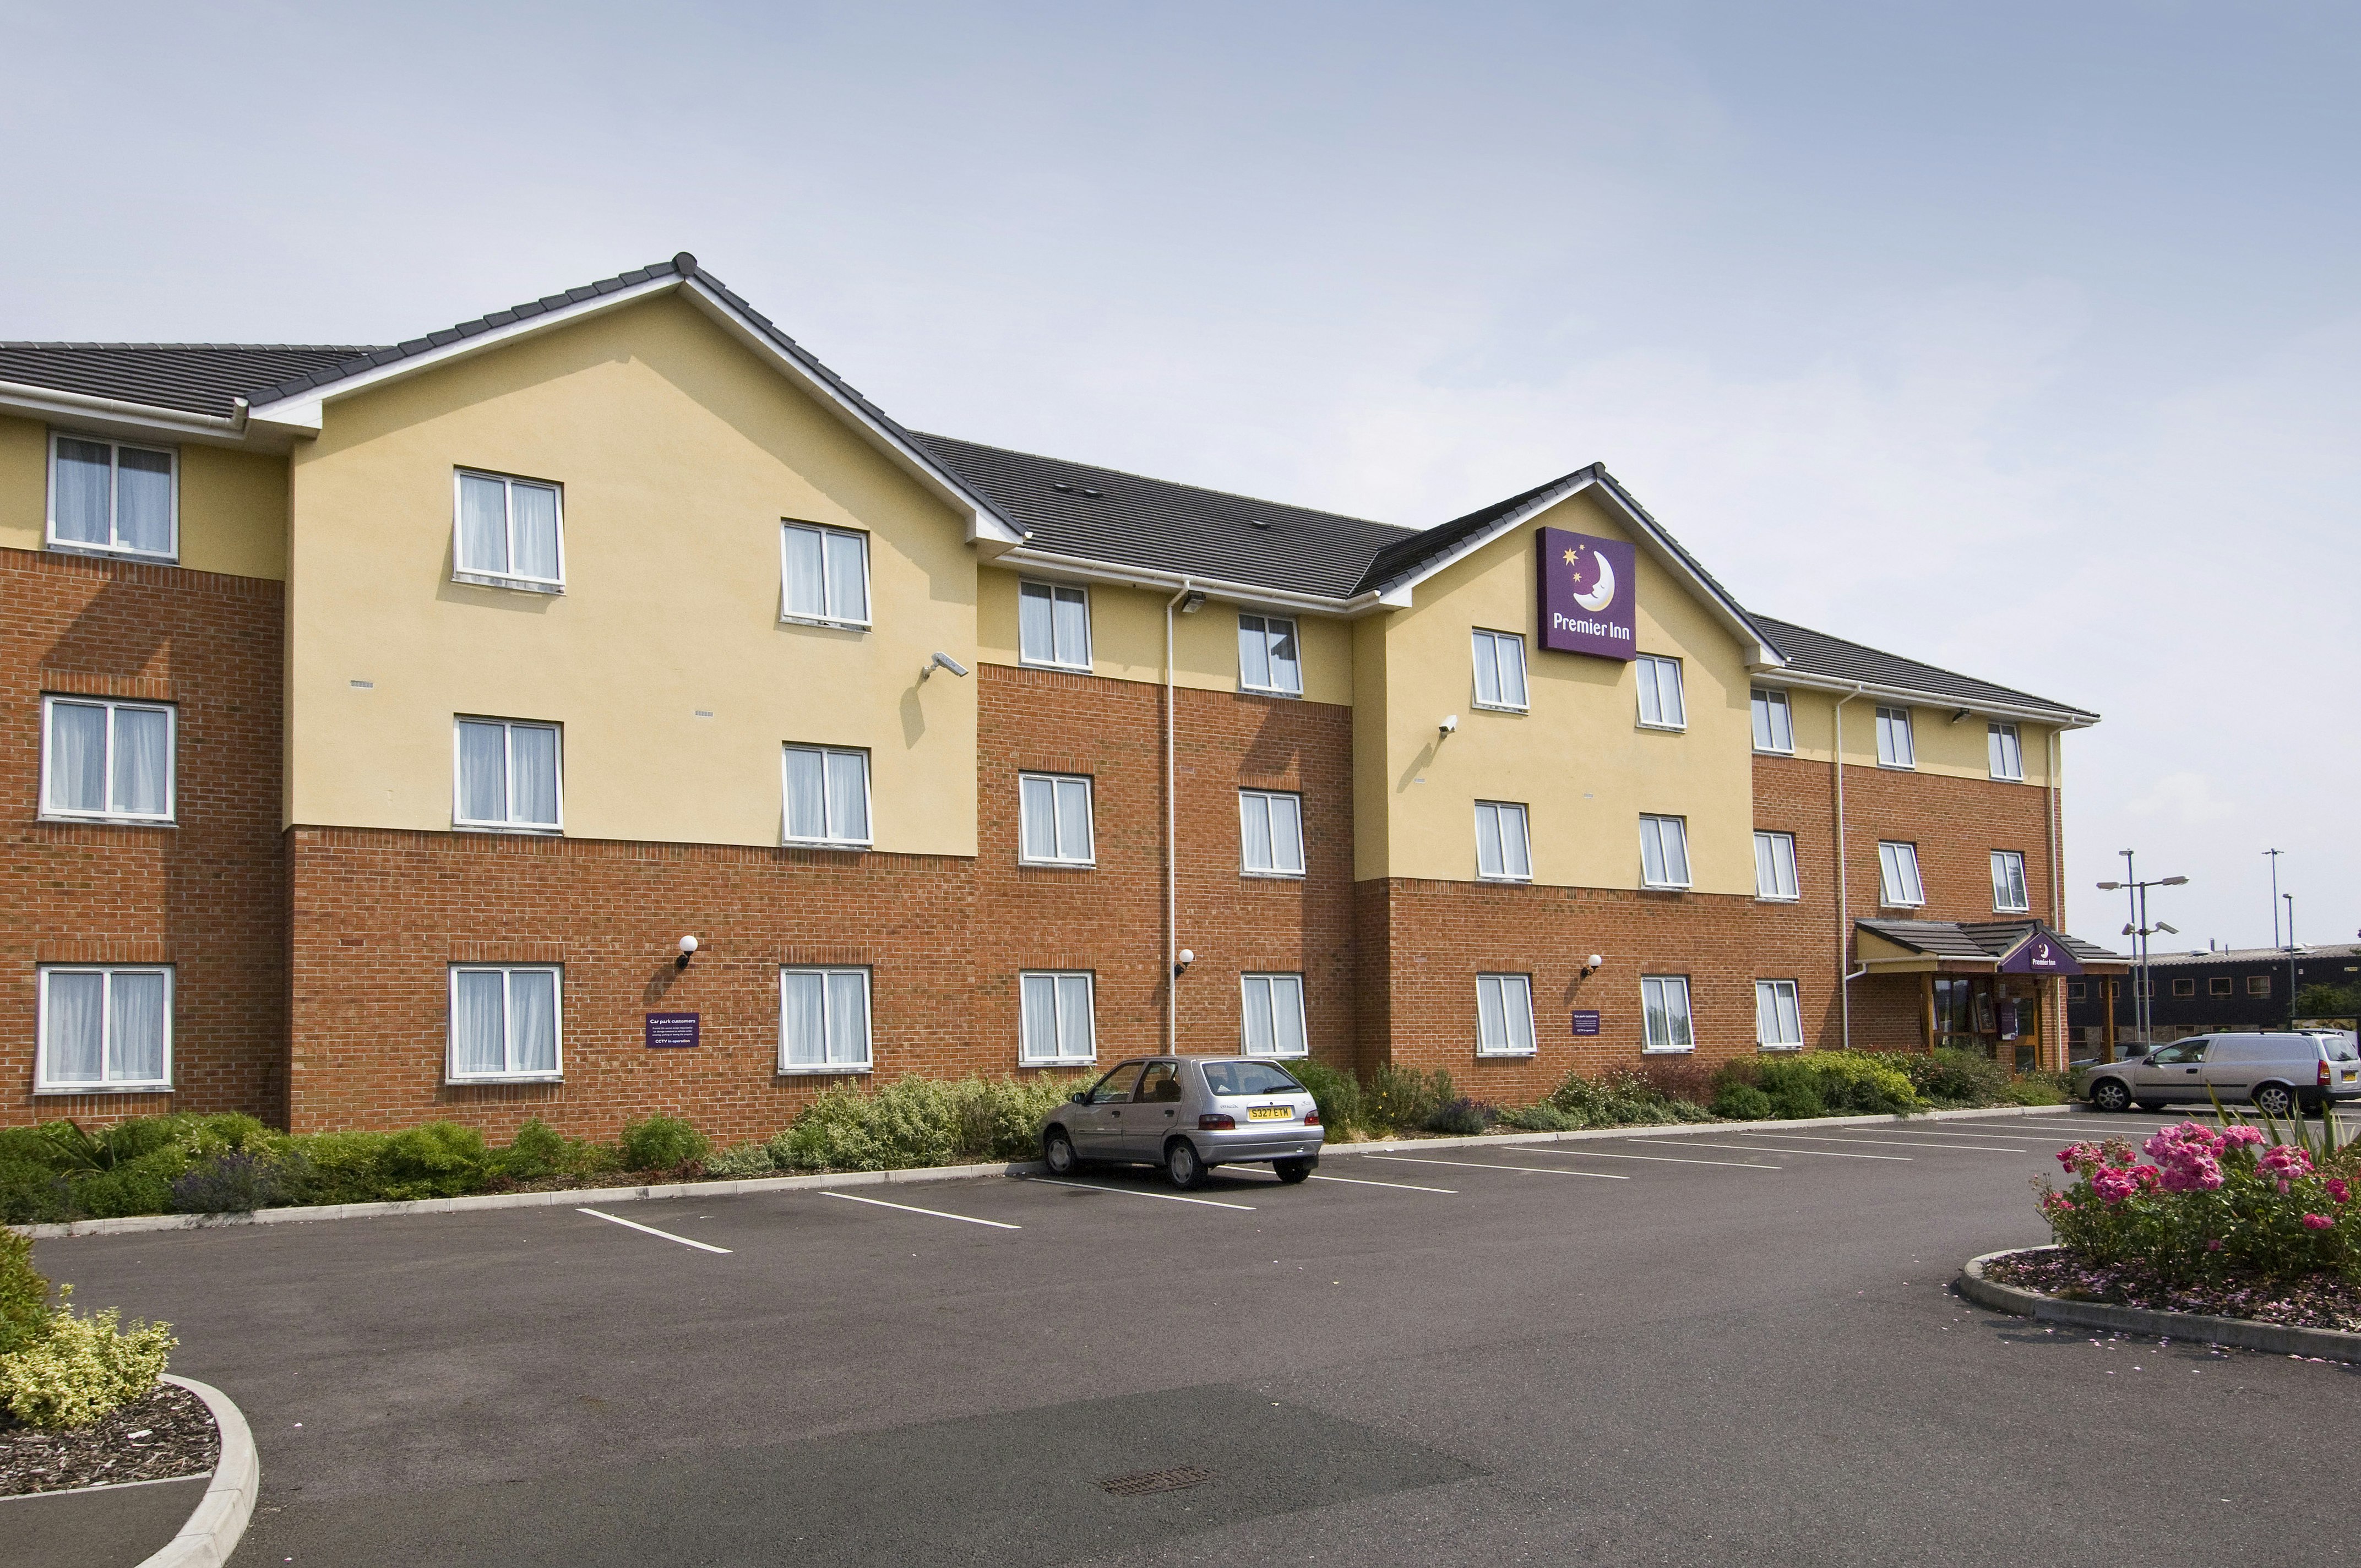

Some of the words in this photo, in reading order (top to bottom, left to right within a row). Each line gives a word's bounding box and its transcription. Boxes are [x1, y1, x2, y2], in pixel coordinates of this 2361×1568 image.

[1554, 612, 1607, 636] Premier
[1610, 622, 1630, 640] Inn
[1252, 1108, 1271, 1118] S327
[1274, 1107, 1288, 1117] ETM
